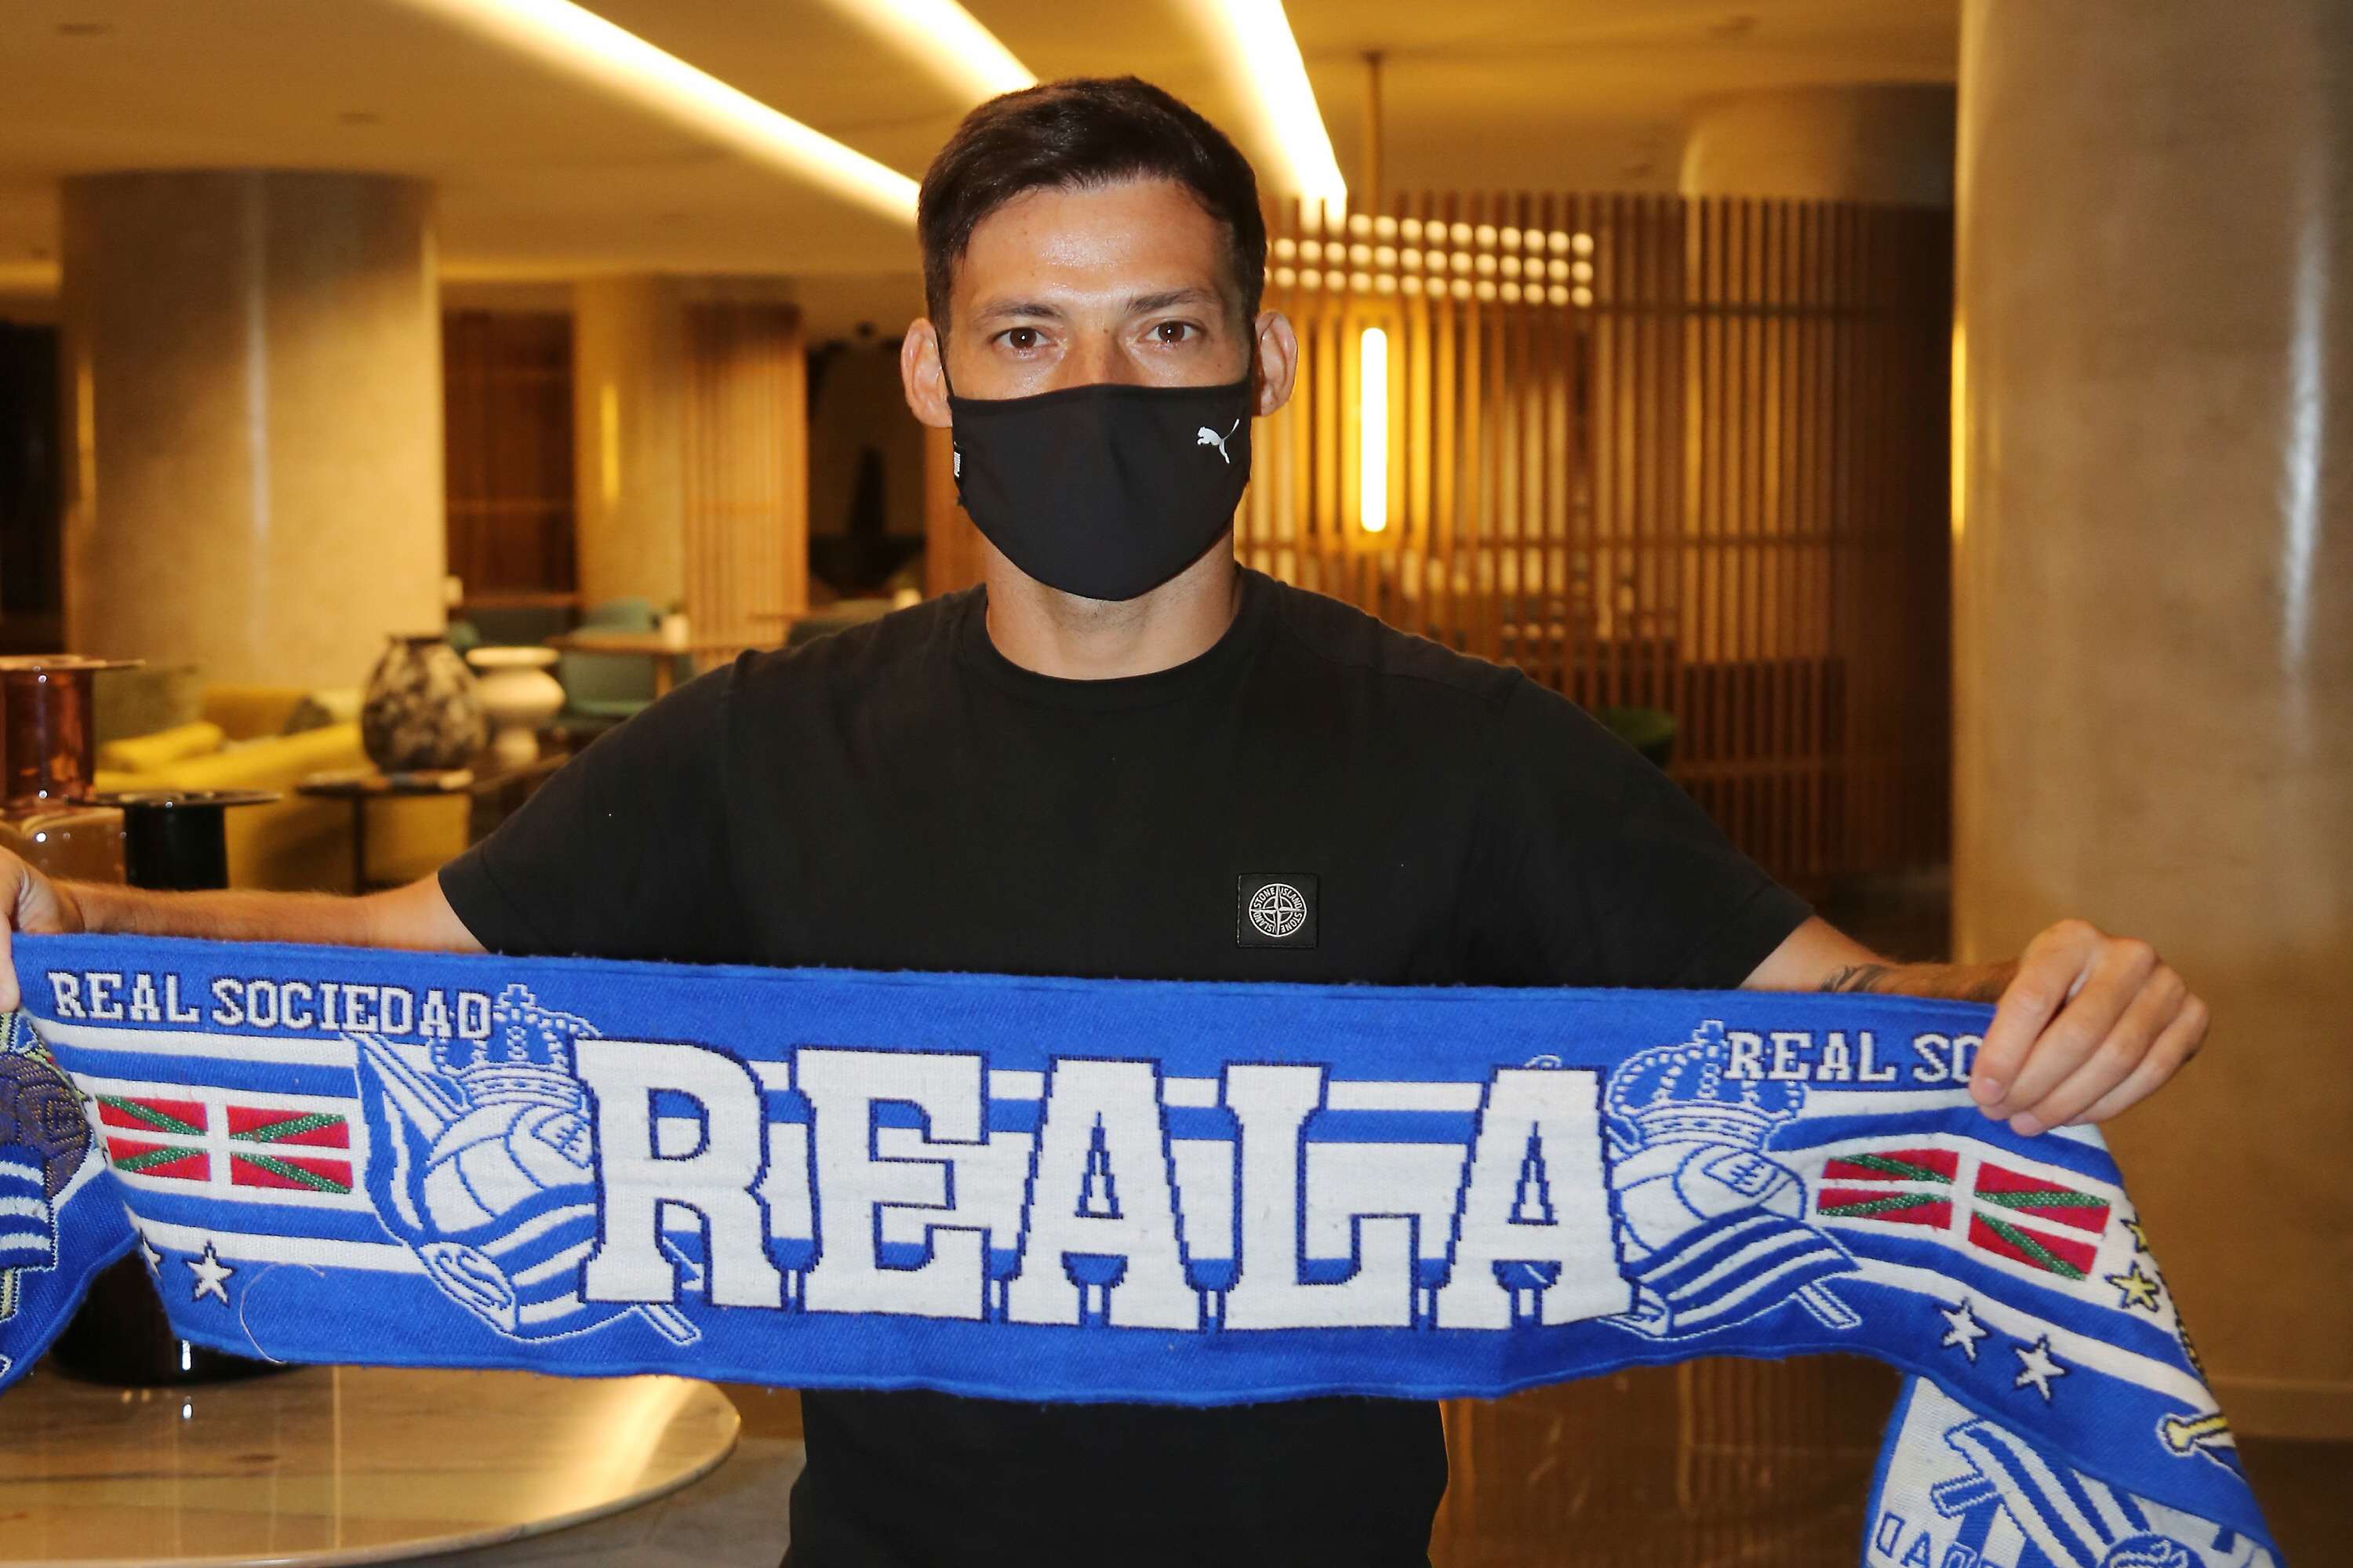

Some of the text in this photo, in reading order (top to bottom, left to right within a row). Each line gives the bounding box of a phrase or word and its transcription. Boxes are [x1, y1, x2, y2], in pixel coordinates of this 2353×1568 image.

[1253, 886, 1303, 909] STONE ISLAND
[1253, 912, 1303, 933] STONE ISLAND
[48, 971, 492, 1040] REAL SOCIEDAD
[1726, 1031, 1896, 1082] REAL
[574, 1039, 1633, 1331] REALA
